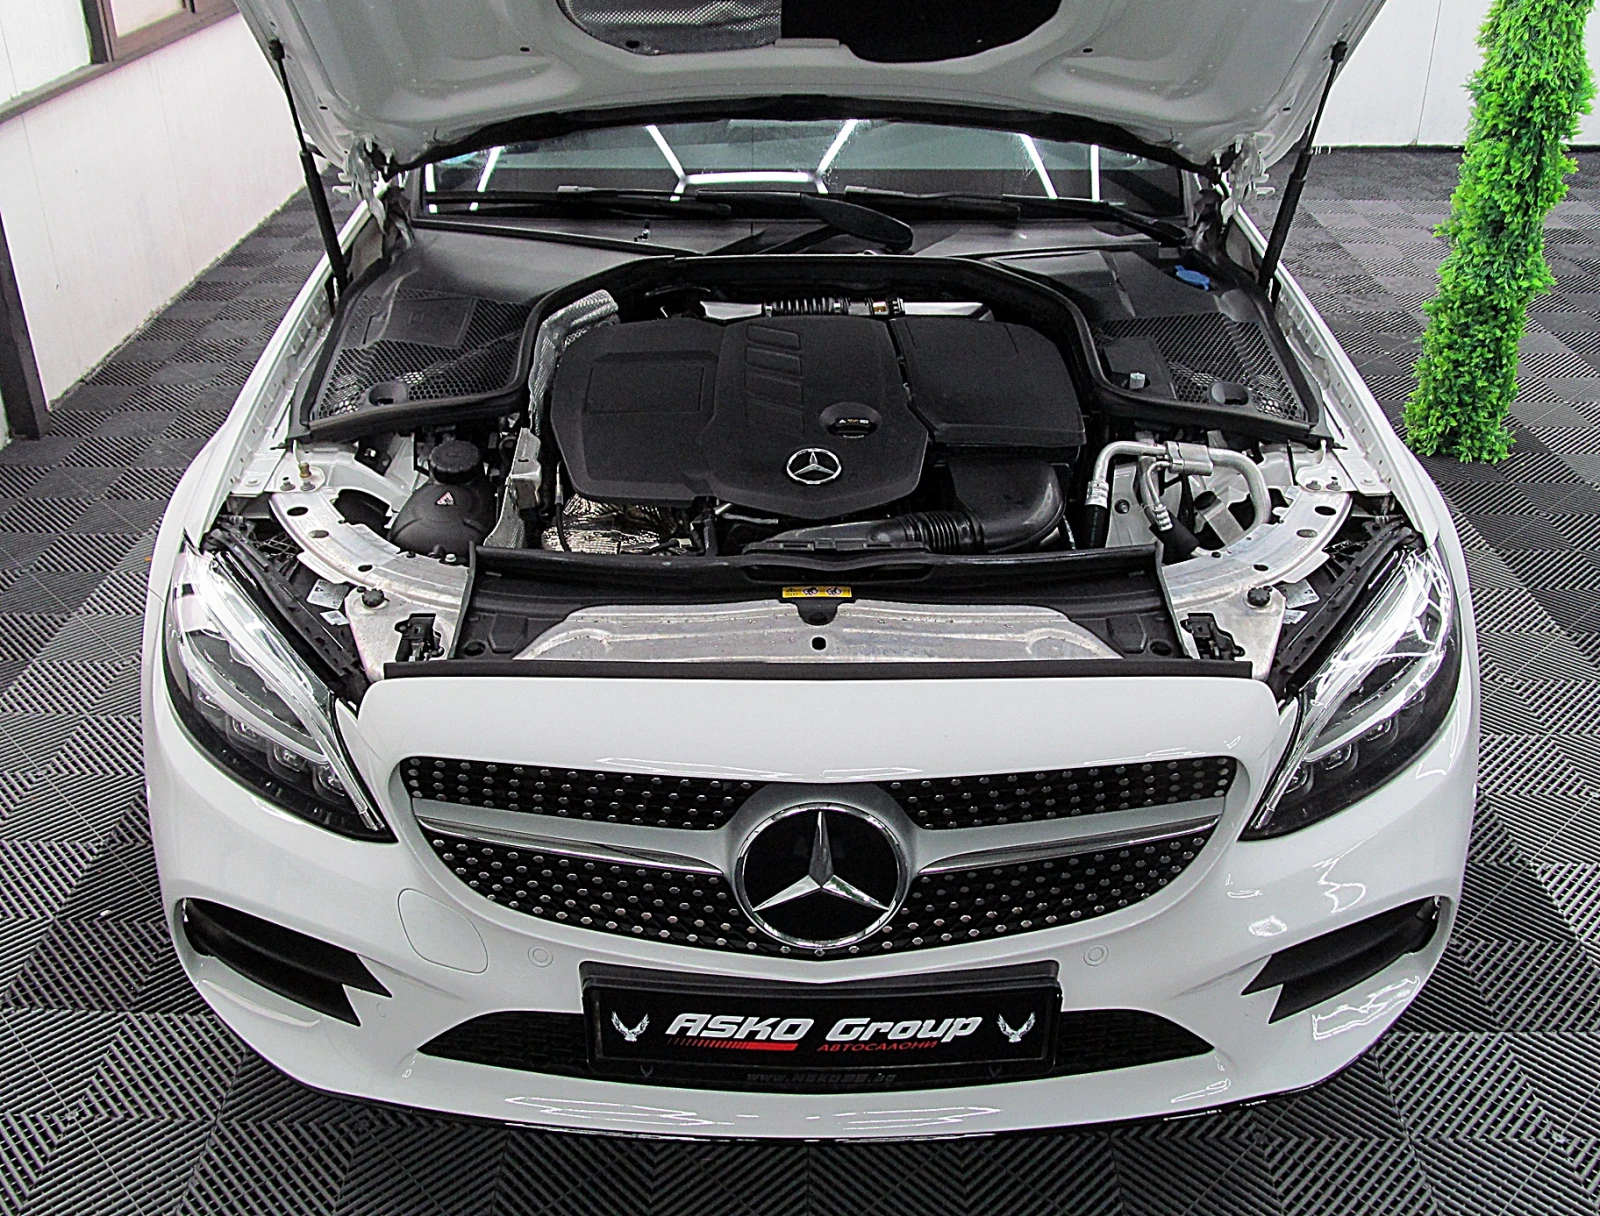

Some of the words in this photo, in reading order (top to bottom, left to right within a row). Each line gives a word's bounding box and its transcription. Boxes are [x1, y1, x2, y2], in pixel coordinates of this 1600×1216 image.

[665, 1013, 815, 1041] ASKO
[825, 1016, 983, 1043] Group
[817, 1040, 938, 1052] АВТОСАЛОНИ
